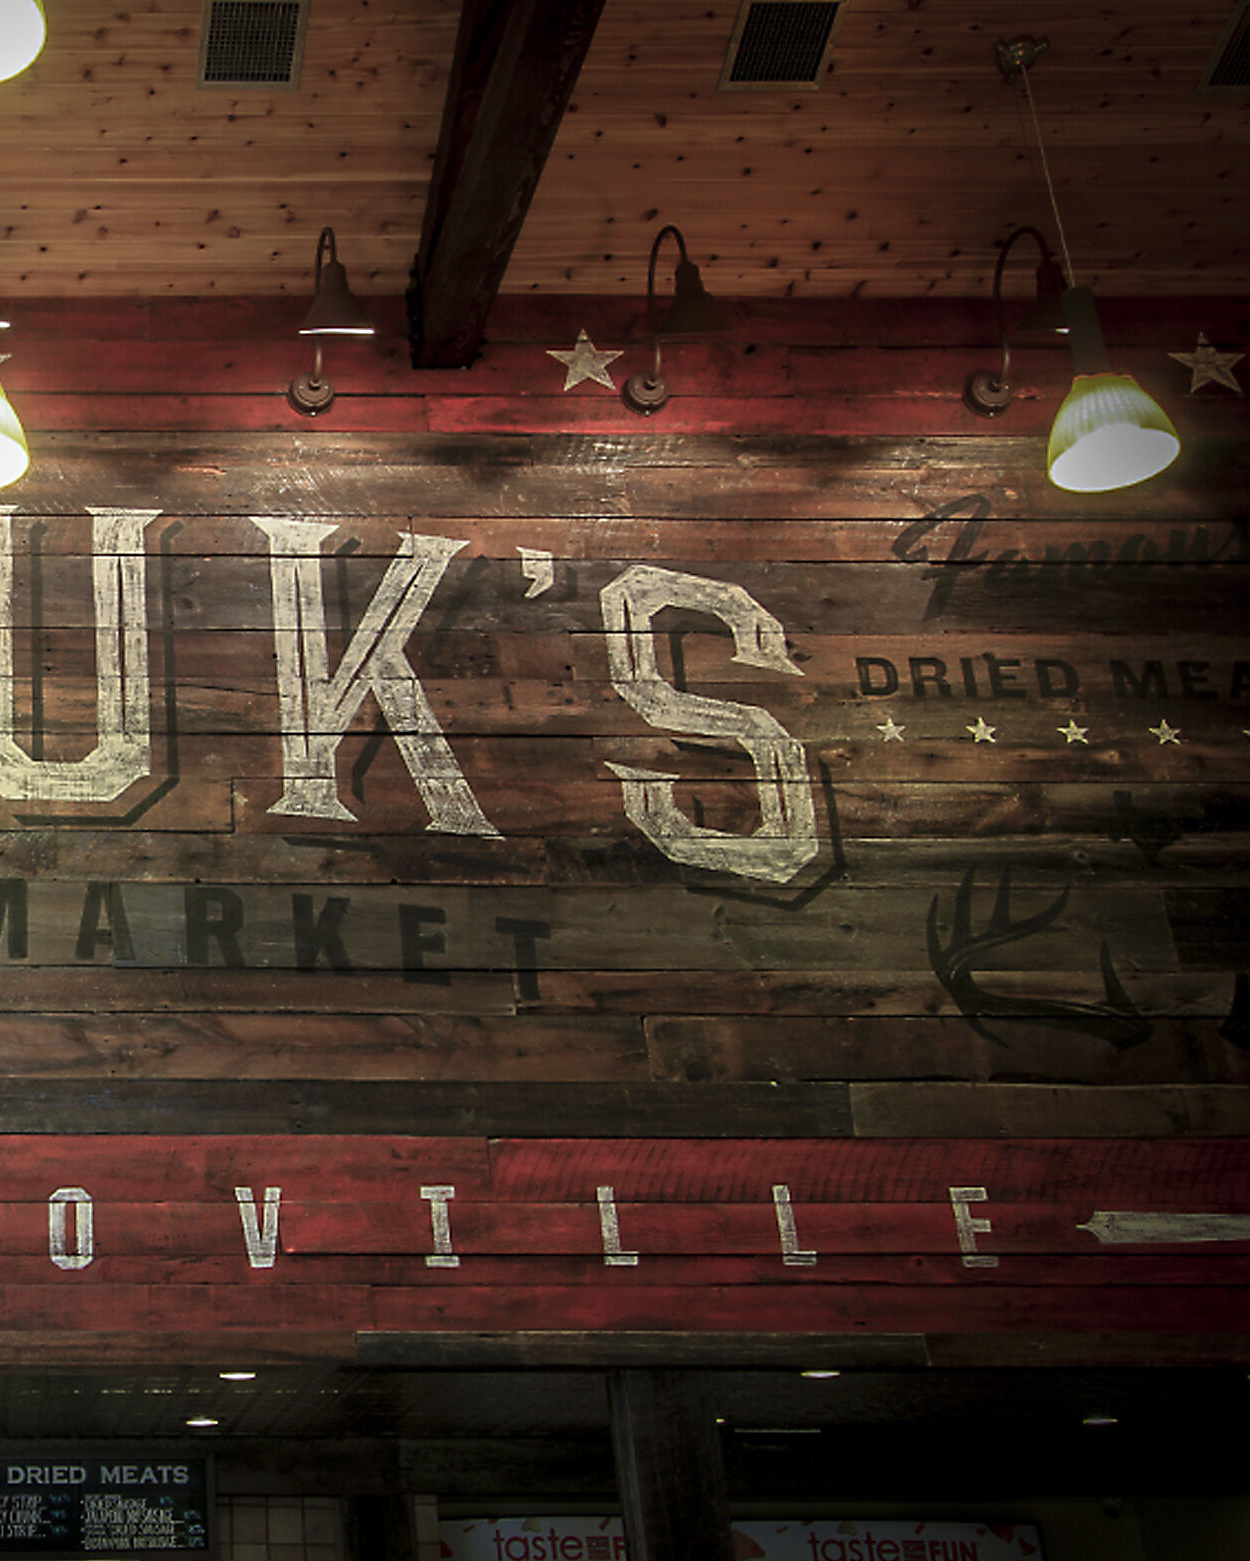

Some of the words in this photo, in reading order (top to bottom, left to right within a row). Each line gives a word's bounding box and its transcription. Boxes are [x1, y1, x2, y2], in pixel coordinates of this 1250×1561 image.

[856, 656, 1080, 698] DRIED
[6, 1465, 87, 1485] DRIED
[101, 1466, 190, 1485] MEATS
[493, 1529, 583, 1561] taste
[808, 1532, 900, 1561] taste
[928, 1540, 978, 1561] FUN
